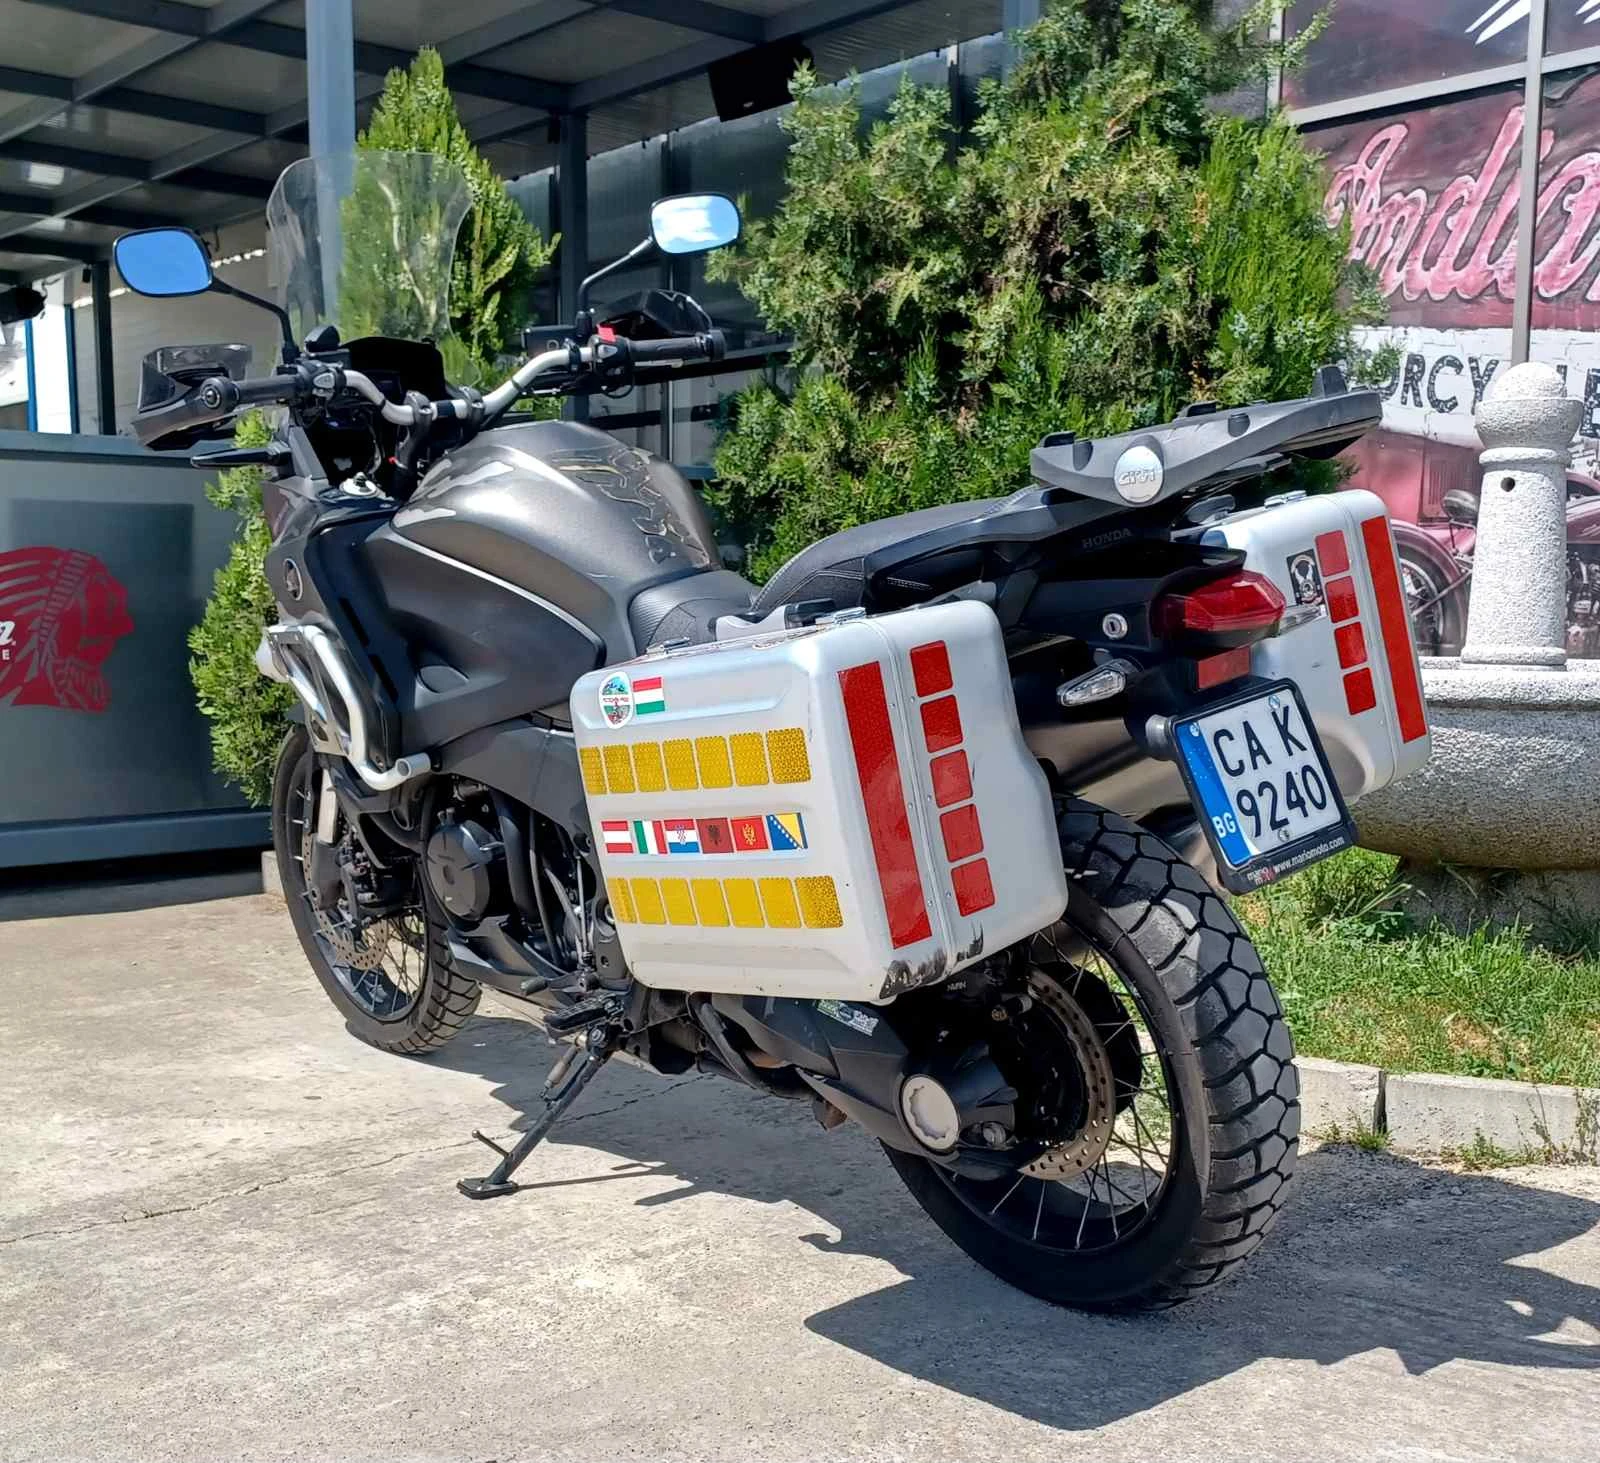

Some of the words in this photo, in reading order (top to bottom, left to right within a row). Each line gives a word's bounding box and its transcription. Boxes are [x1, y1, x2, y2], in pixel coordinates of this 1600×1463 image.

[1082, 528, 1132, 549] HONDA
[1235, 764, 1327, 838] 9240
[1212, 812, 1237, 839] BG
[1273, 836, 1345, 873] www.mariomoto.com
